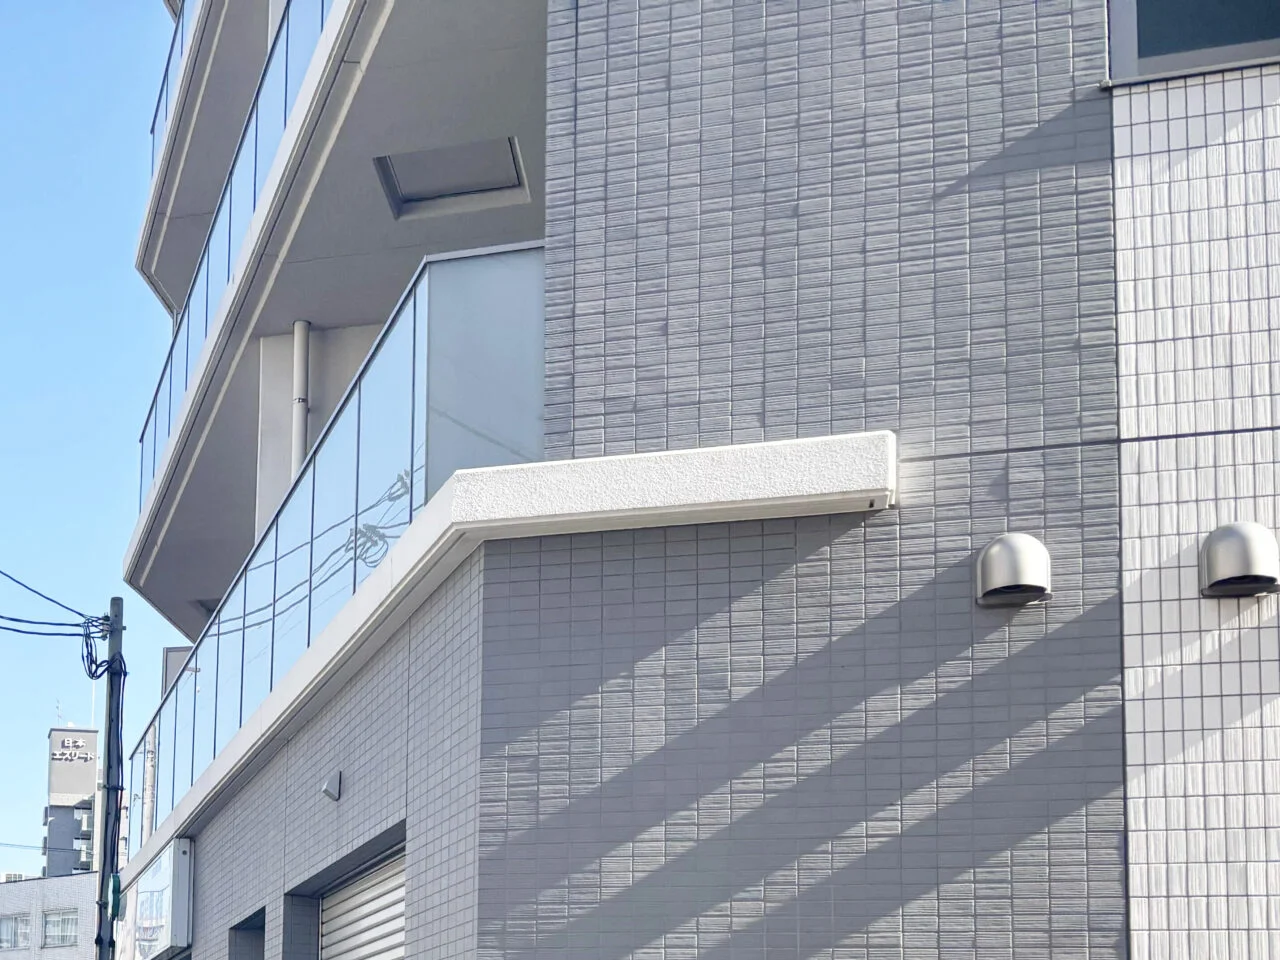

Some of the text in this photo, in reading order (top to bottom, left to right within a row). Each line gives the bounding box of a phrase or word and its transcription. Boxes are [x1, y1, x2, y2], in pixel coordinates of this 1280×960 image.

[63, 738, 87, 748] 日本
[53, 750, 95, 760] エスリード
